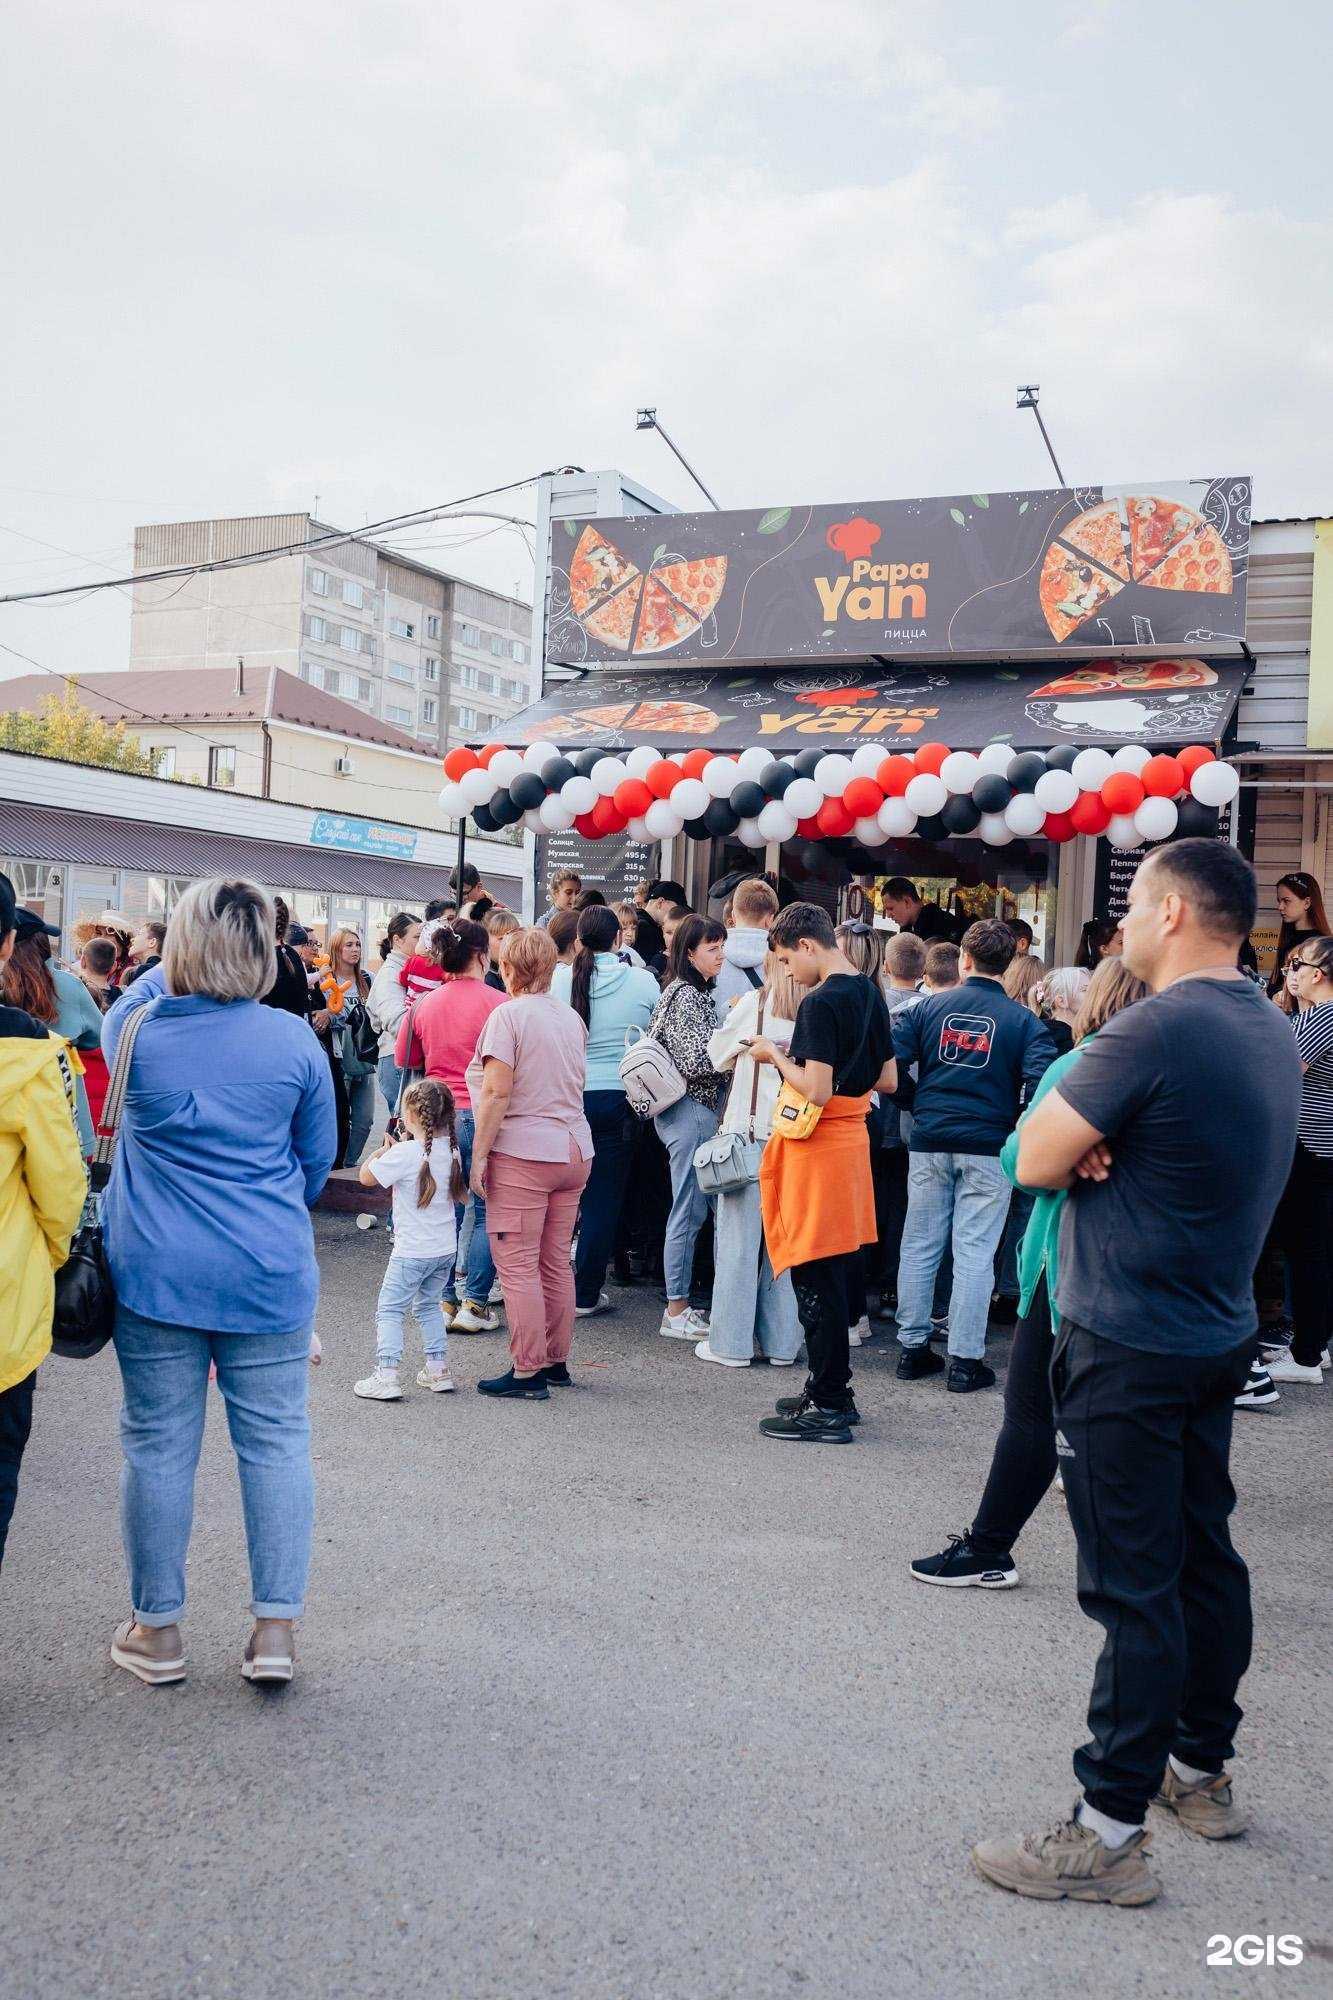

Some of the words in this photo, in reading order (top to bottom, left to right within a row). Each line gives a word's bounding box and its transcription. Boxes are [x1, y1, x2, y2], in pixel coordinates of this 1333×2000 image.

[852, 560, 929, 586] Papa
[814, 575, 927, 621] Yan
[884, 629, 927, 640] ПИЦЦА
[818, 705, 940, 719] Papa
[757, 713, 926, 734] Yan
[548, 838, 575, 847] Солнце
[547, 850, 580, 859] Мужская
[624, 851, 640, 859] 495
[1111, 847, 1146, 856] Сырная
[547, 860, 584, 870] Питерская
[625, 862, 639, 870] 315
